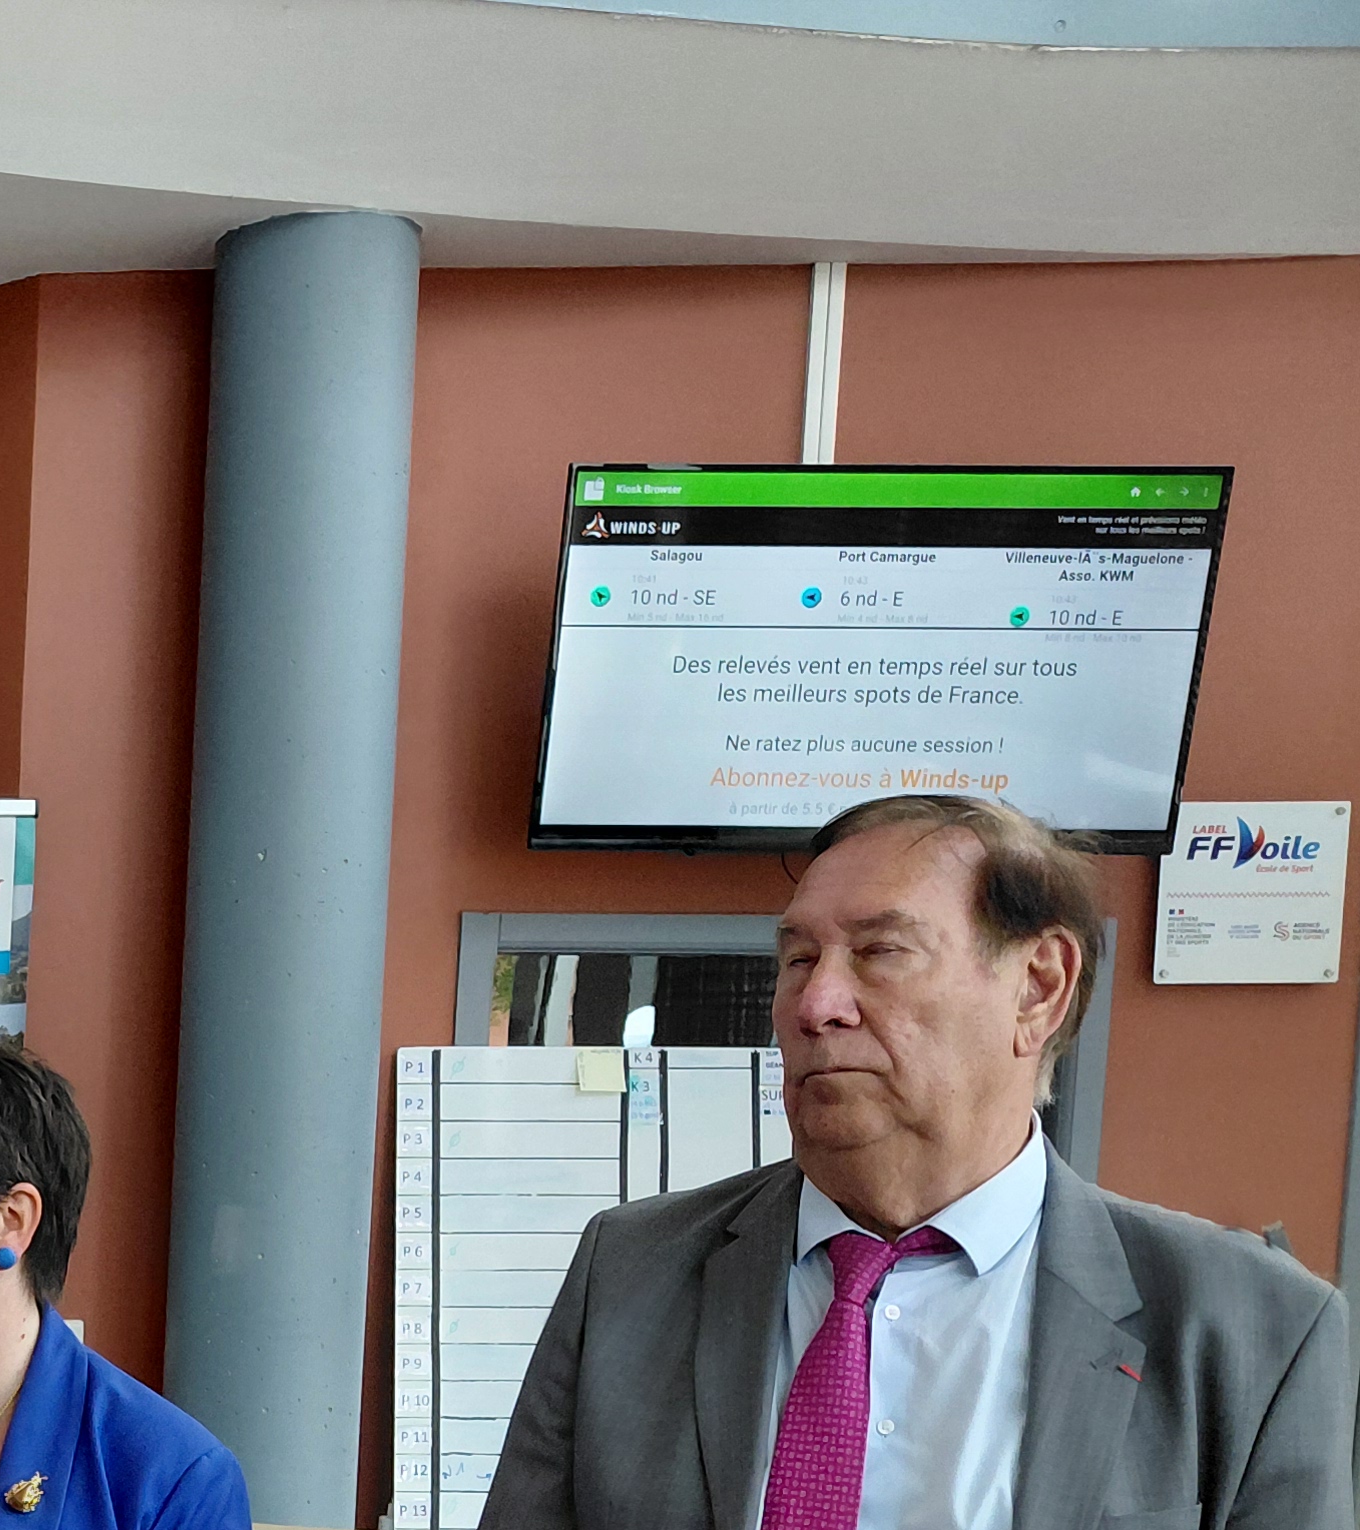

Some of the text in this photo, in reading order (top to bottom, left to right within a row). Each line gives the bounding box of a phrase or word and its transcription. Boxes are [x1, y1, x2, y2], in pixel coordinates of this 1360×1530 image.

[616, 484, 682, 494] Kiosk Browser
[650, 549, 704, 565] Salagou
[839, 551, 937, 566] Port Camargue
[1058, 569, 1134, 582] Asso. KWM
[631, 588, 717, 606] 10 nd SE
[840, 589, 904, 607] 6 nd E
[1050, 609, 1124, 626] 10 nd E
[673, 655, 1077, 679] Des relevés vent en temps réel sur tous
[717, 683, 1024, 707] les meilleurs spots de France.
[725, 735, 750, 751] Ne
[756, 736, 801, 752] ratez
[806, 735, 846, 755] plus
[851, 737, 917, 753] aucune
[922, 735, 993, 753] session
[710, 767, 1009, 794] Abonnez-vous à Winds-up
[729, 802, 737, 815] à
[741, 802, 778, 817] partir
[781, 803, 798, 815] de
[802, 803, 823, 816] 5.5
[1192, 825, 1228, 834] LABEL
[1186, 816, 1320, 869] FFVoile
[1291, 864, 1314, 874] Sport
[634, 1052, 653, 1063] K 4
[405, 1062, 424, 1073] P 1
[631, 1081, 650, 1092] K 3
[405, 1099, 424, 1110] P 2
[403, 1134, 423, 1145] P 3
[402, 1171, 421, 1182] P 4
[402, 1208, 421, 1219] P 5
[403, 1246, 422, 1257] P 6
[402, 1283, 422, 1294] P 7
[414, 1323, 422, 1334] 8
[402, 1358, 422, 1369] P 9
[415, 1394, 429, 1406] 10
[401, 1432, 429, 1442] P 11
[414, 1464, 428, 1476] 12
[400, 1505, 427, 1516] P 13
